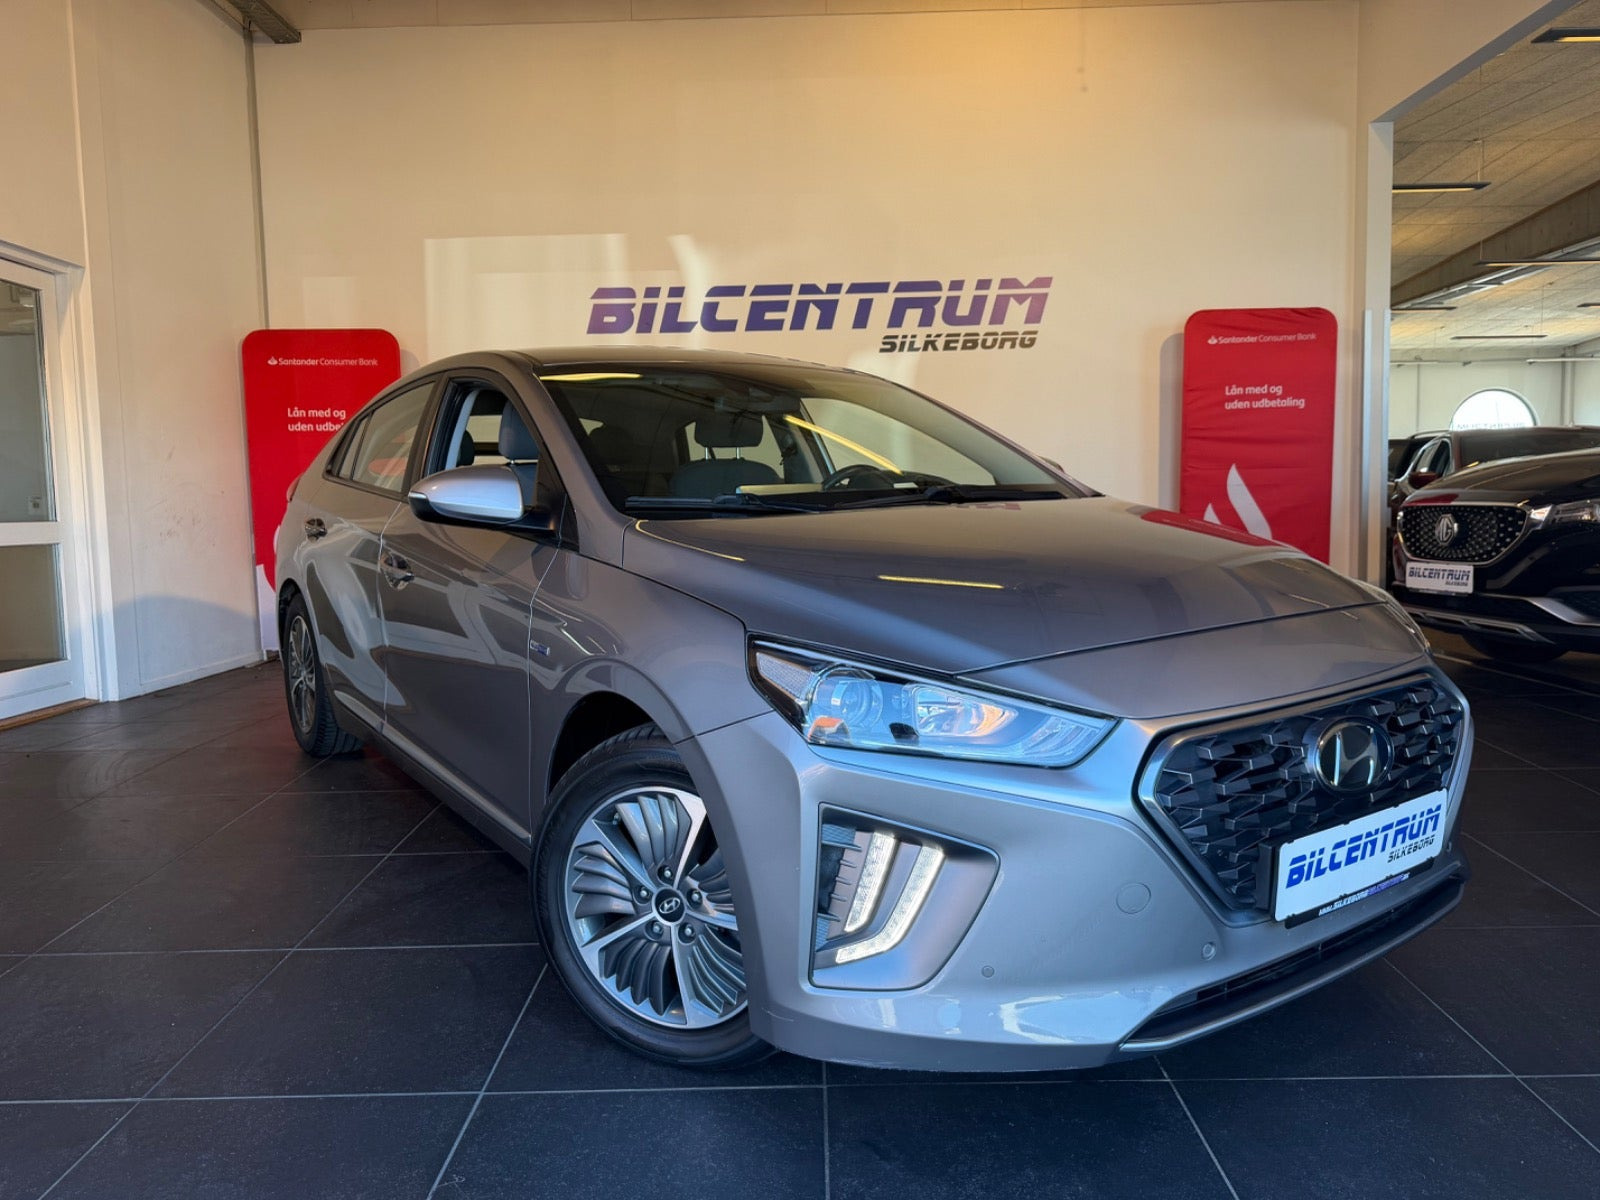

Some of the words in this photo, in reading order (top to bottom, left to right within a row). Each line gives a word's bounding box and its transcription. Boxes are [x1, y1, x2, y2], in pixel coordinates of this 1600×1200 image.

[586, 276, 1053, 335] BILCENTRUM
[878, 330, 1038, 353] SILKEBORG
[1218, 335, 1257, 345] Santander
[1259, 334, 1296, 342] Consumer
[1297, 333, 1316, 341] Bank
[278, 358, 318, 366] Santander
[320, 358, 358, 366] Consumer
[359, 358, 378, 366] Bank
[1225, 385, 1243, 395] Lån
[1245, 384, 1268, 394] med
[1269, 385, 1283, 396] og
[1225, 399, 1250, 410] uden
[1252, 397, 1305, 409] udbetaling
[287, 406, 306, 417] Lån
[308, 407, 331, 417] med
[333, 410, 346, 420] og
[288, 421, 314, 431] uden
[1408, 566, 1471, 581] BILCENTRUM
[1286, 804, 1442, 889] BILCENTRUM
[1387, 834, 1436, 863] SILKEBORG
